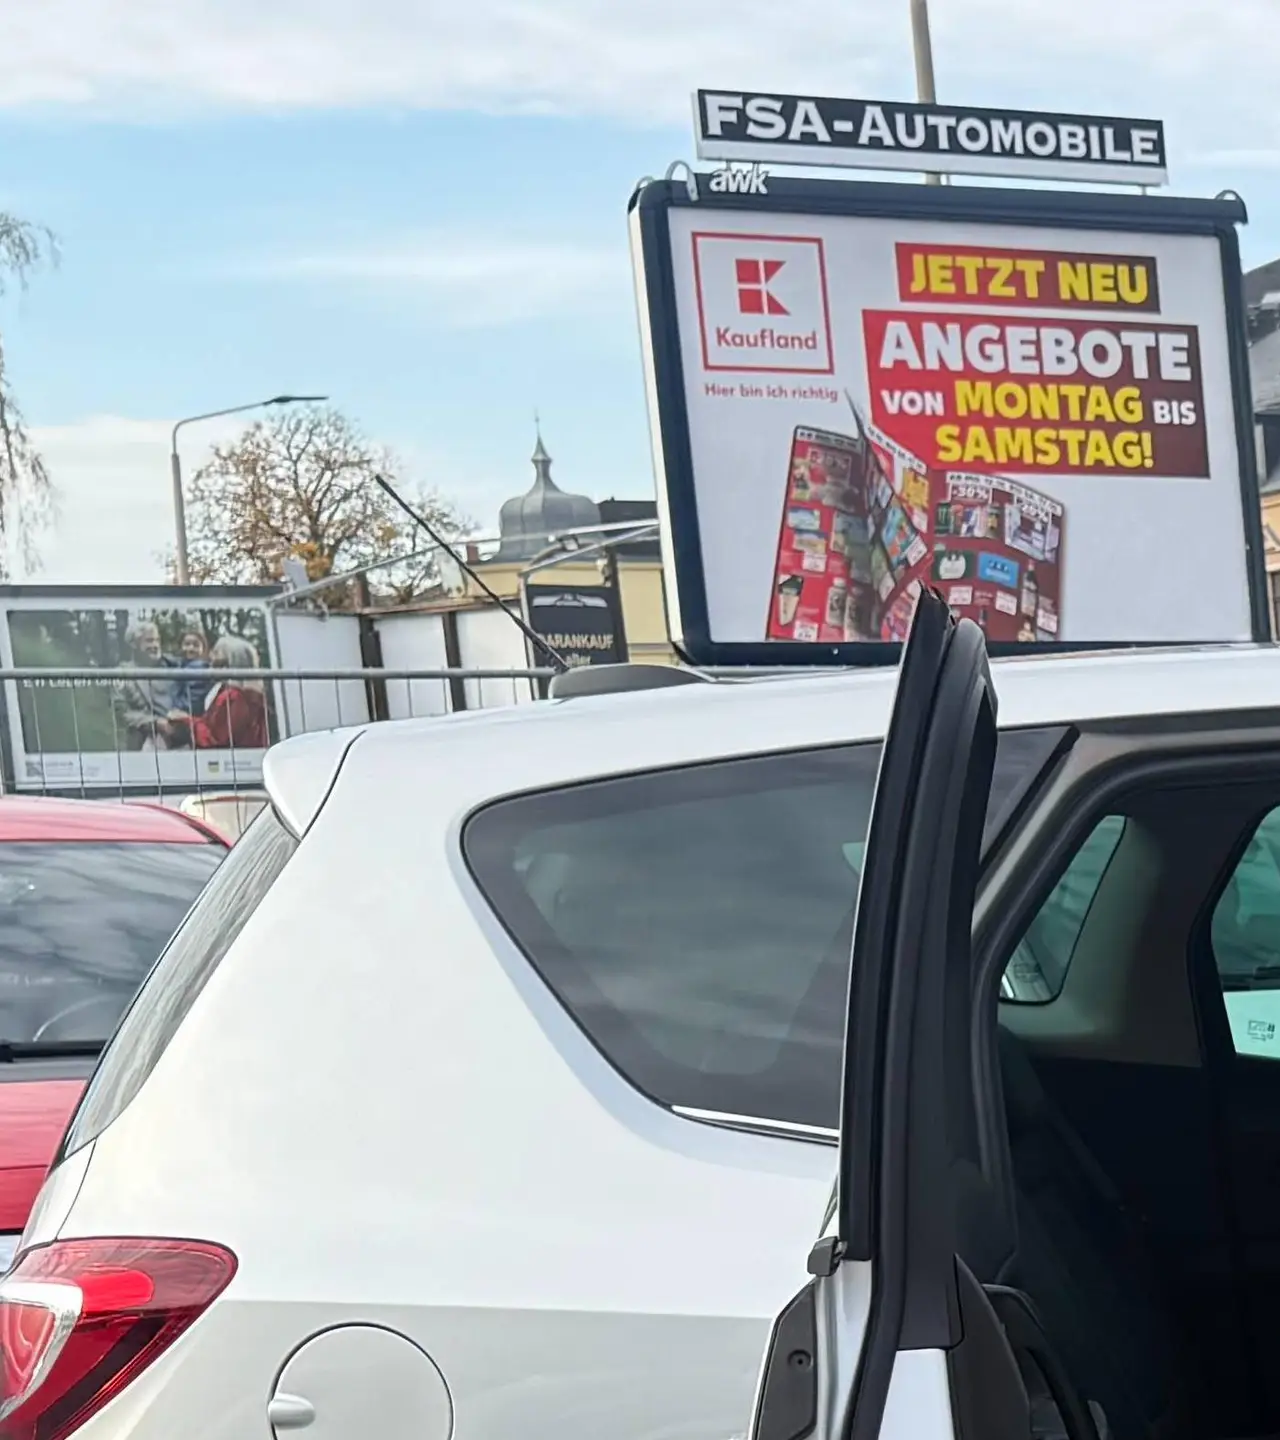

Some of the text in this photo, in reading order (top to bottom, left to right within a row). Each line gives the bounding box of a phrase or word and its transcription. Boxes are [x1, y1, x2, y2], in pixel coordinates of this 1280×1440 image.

[703, 94, 1161, 164] FSA-AUTOMOBILE
[709, 162, 770, 196] awk
[910, 253, 1149, 304] JETZT NEU
[716, 327, 818, 350] Kaufland
[879, 320, 1193, 382] ANGEBOTE
[704, 382, 839, 403] Hier bin ich richtig
[881, 379, 1197, 426] VON MONTAG BIS
[935, 424, 1154, 469] SAMSTAG!
